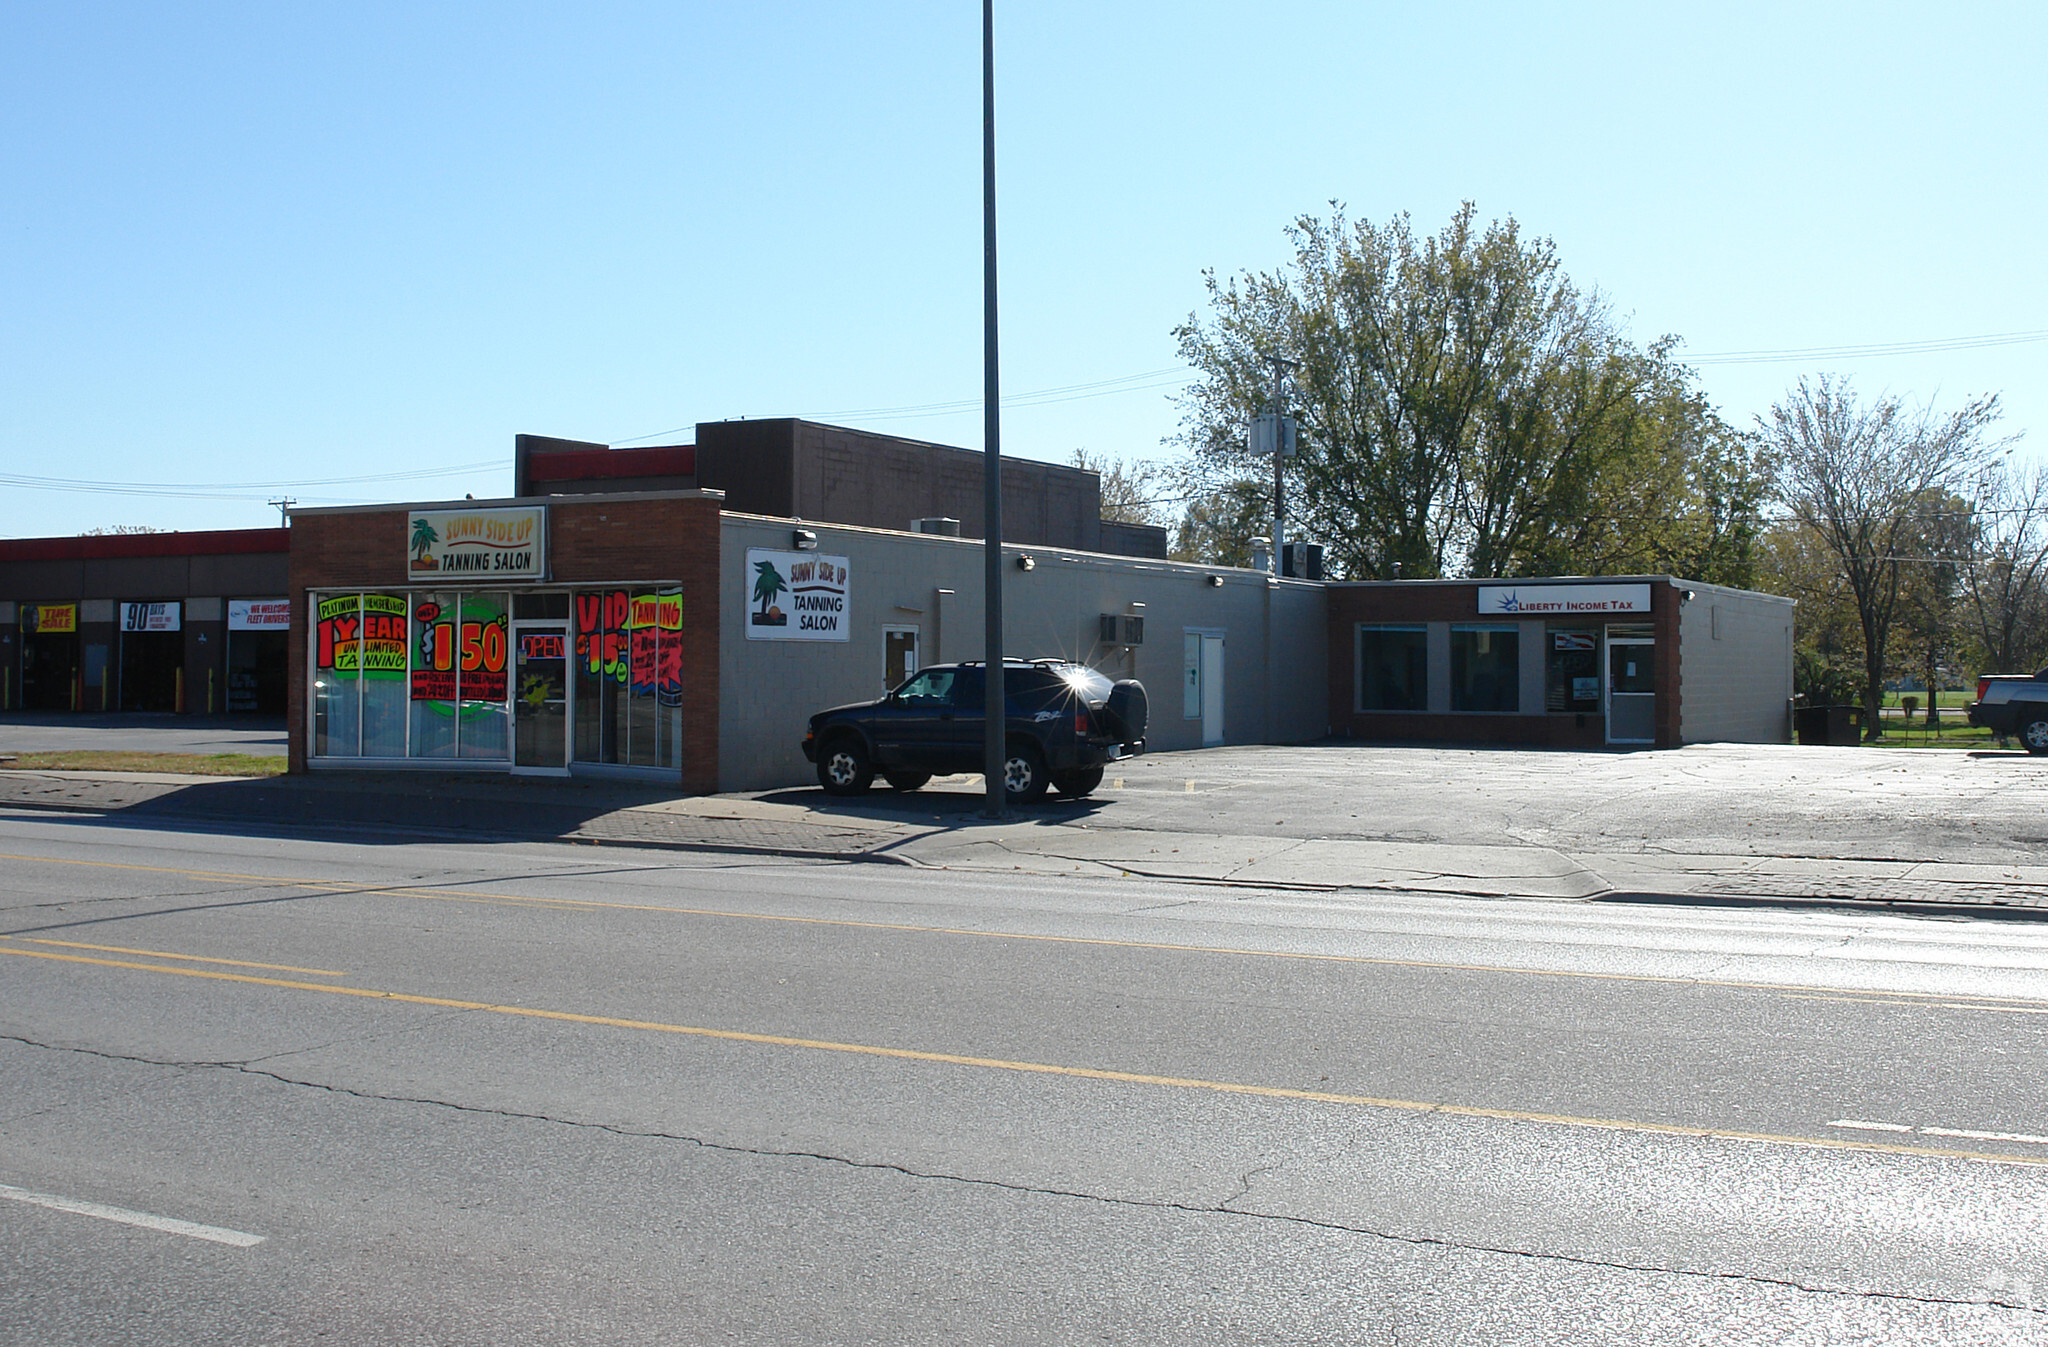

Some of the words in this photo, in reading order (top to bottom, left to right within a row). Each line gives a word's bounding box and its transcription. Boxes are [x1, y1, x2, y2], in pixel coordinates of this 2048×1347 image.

[446, 516, 483, 540] SUNNY
[487, 520, 514, 542] SIDE
[517, 518, 533, 542] UP
[443, 553, 490, 571] TANNING
[494, 552, 531, 570] SALON
[791, 561, 817, 583] SUNNY
[819, 562, 834, 582] SIDE
[837, 567, 847, 585] UP
[44, 608, 72, 618] TIRE
[251, 604, 261, 613] WE
[321, 598, 359, 618] PLATINUM
[577, 592, 627, 632] VIP
[794, 595, 843, 612] TANNING
[1519, 601, 1563, 611] LIBERTY
[1566, 601, 1607, 611] INCOME
[1610, 600, 1633, 610] TAX
[41, 618, 71, 629] SALE
[127, 603, 149, 630] 90
[247, 615, 263, 624] FLEET
[631, 601, 680, 628] TANNING
[800, 615, 837, 631] SALON
[318, 619, 334, 667] 1
[333, 616, 407, 641] YEAR
[523, 636, 565, 658] OPEN
[338, 653, 407, 667] TANNING
